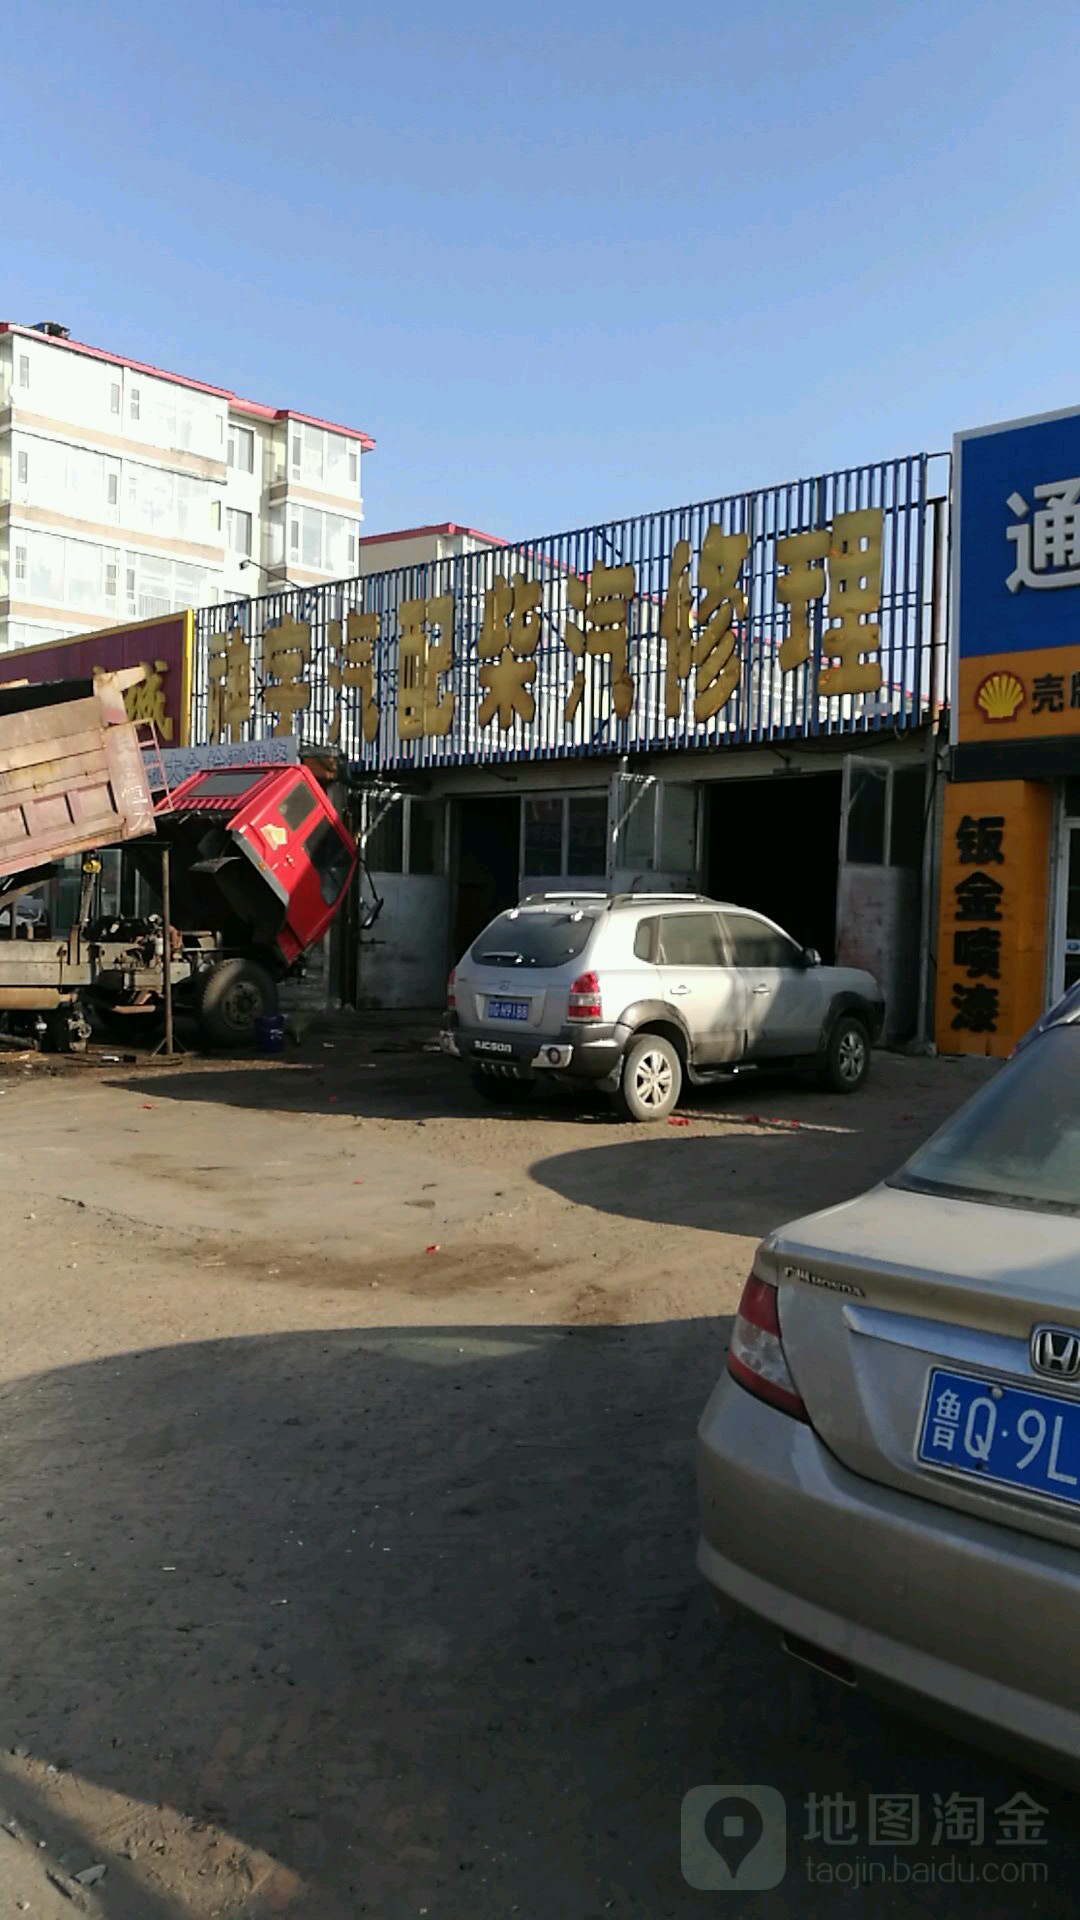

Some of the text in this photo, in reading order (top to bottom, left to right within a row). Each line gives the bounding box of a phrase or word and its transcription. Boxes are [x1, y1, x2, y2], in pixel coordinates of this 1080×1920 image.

[1005, 479, 1080, 594] 通
[950, 815, 1006, 1034] 钣金喷漆
